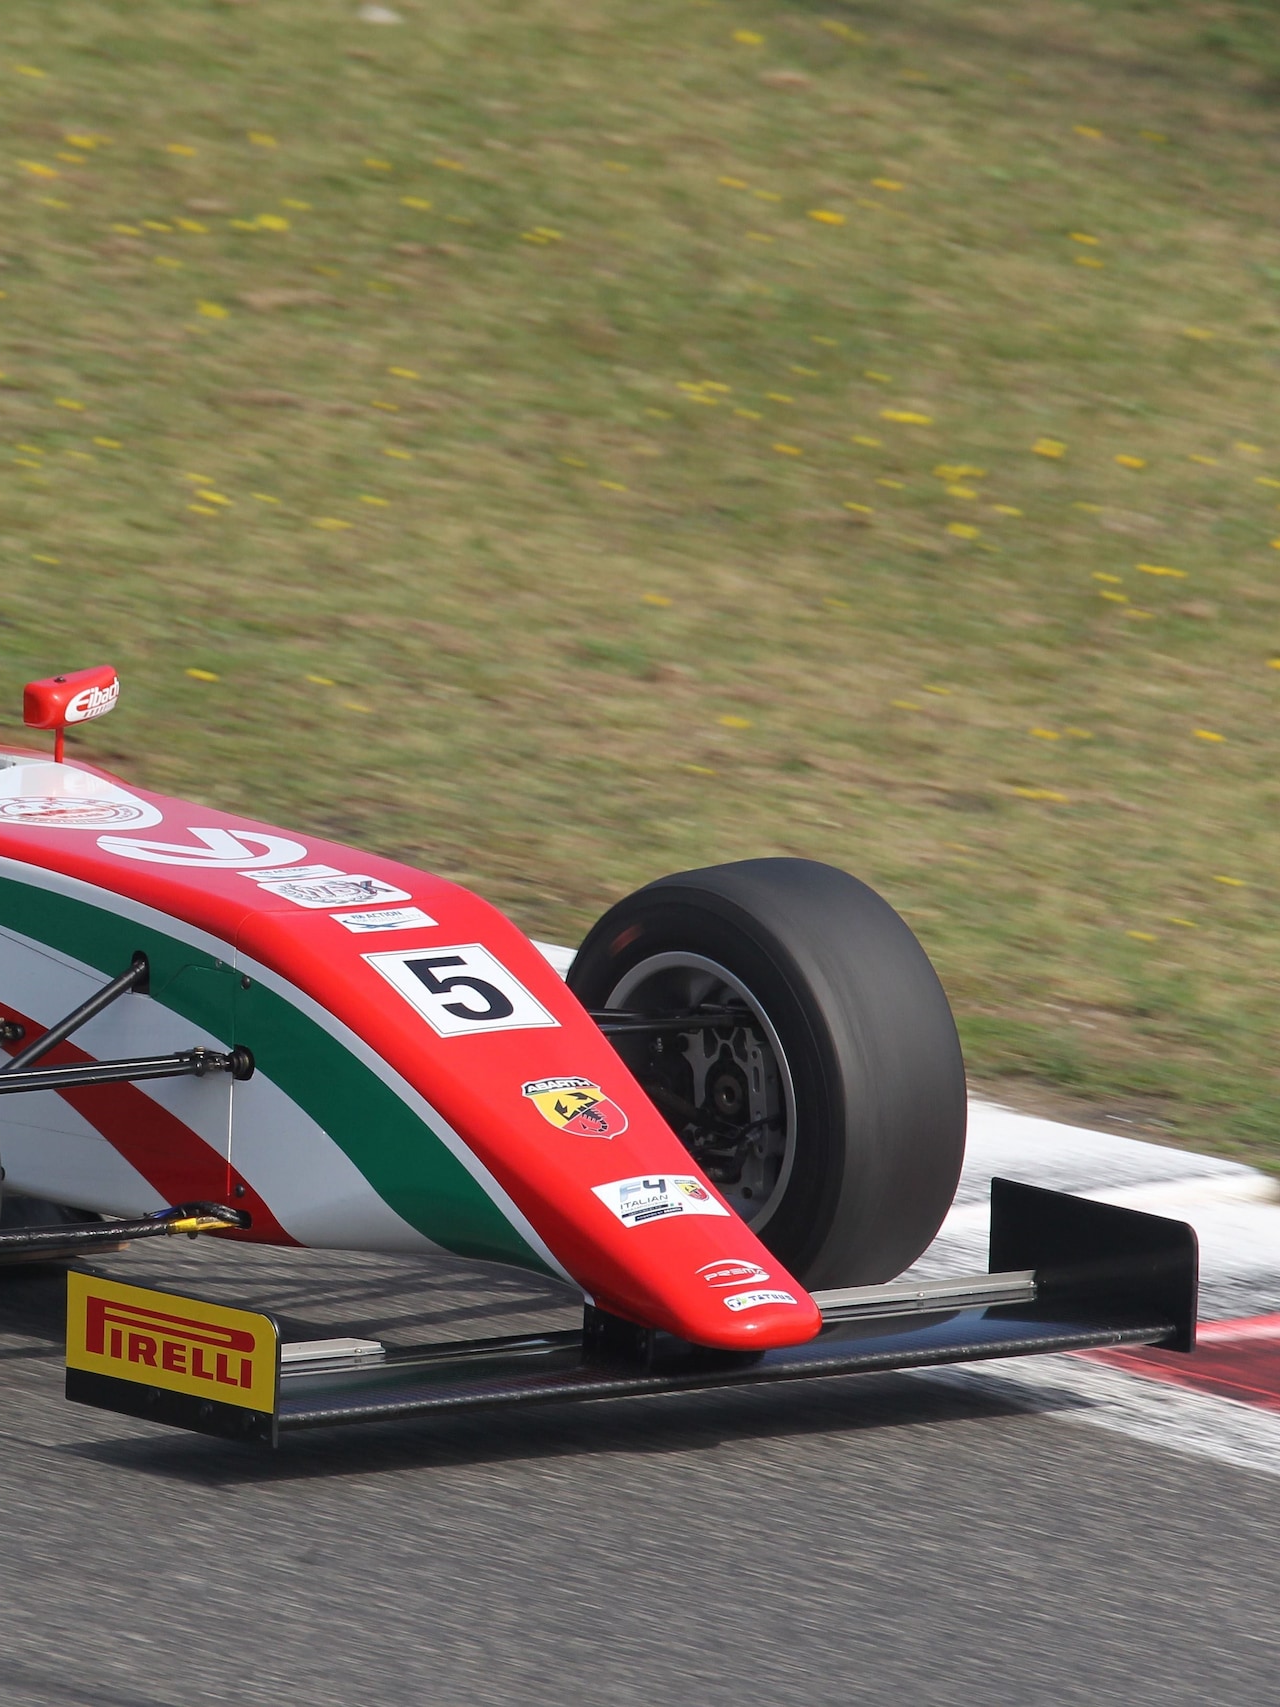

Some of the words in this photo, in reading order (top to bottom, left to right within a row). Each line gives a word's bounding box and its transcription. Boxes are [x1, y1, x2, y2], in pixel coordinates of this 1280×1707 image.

[65, 676, 120, 722] Eibach
[402, 955, 515, 1021] 5
[526, 1079, 591, 1093] ABARTH
[619, 1179, 667, 1203] F4
[620, 1194, 669, 1210] ITALIAN
[703, 1267, 768, 1282] PREMA
[85, 1295, 257, 1390] PIRELLI
